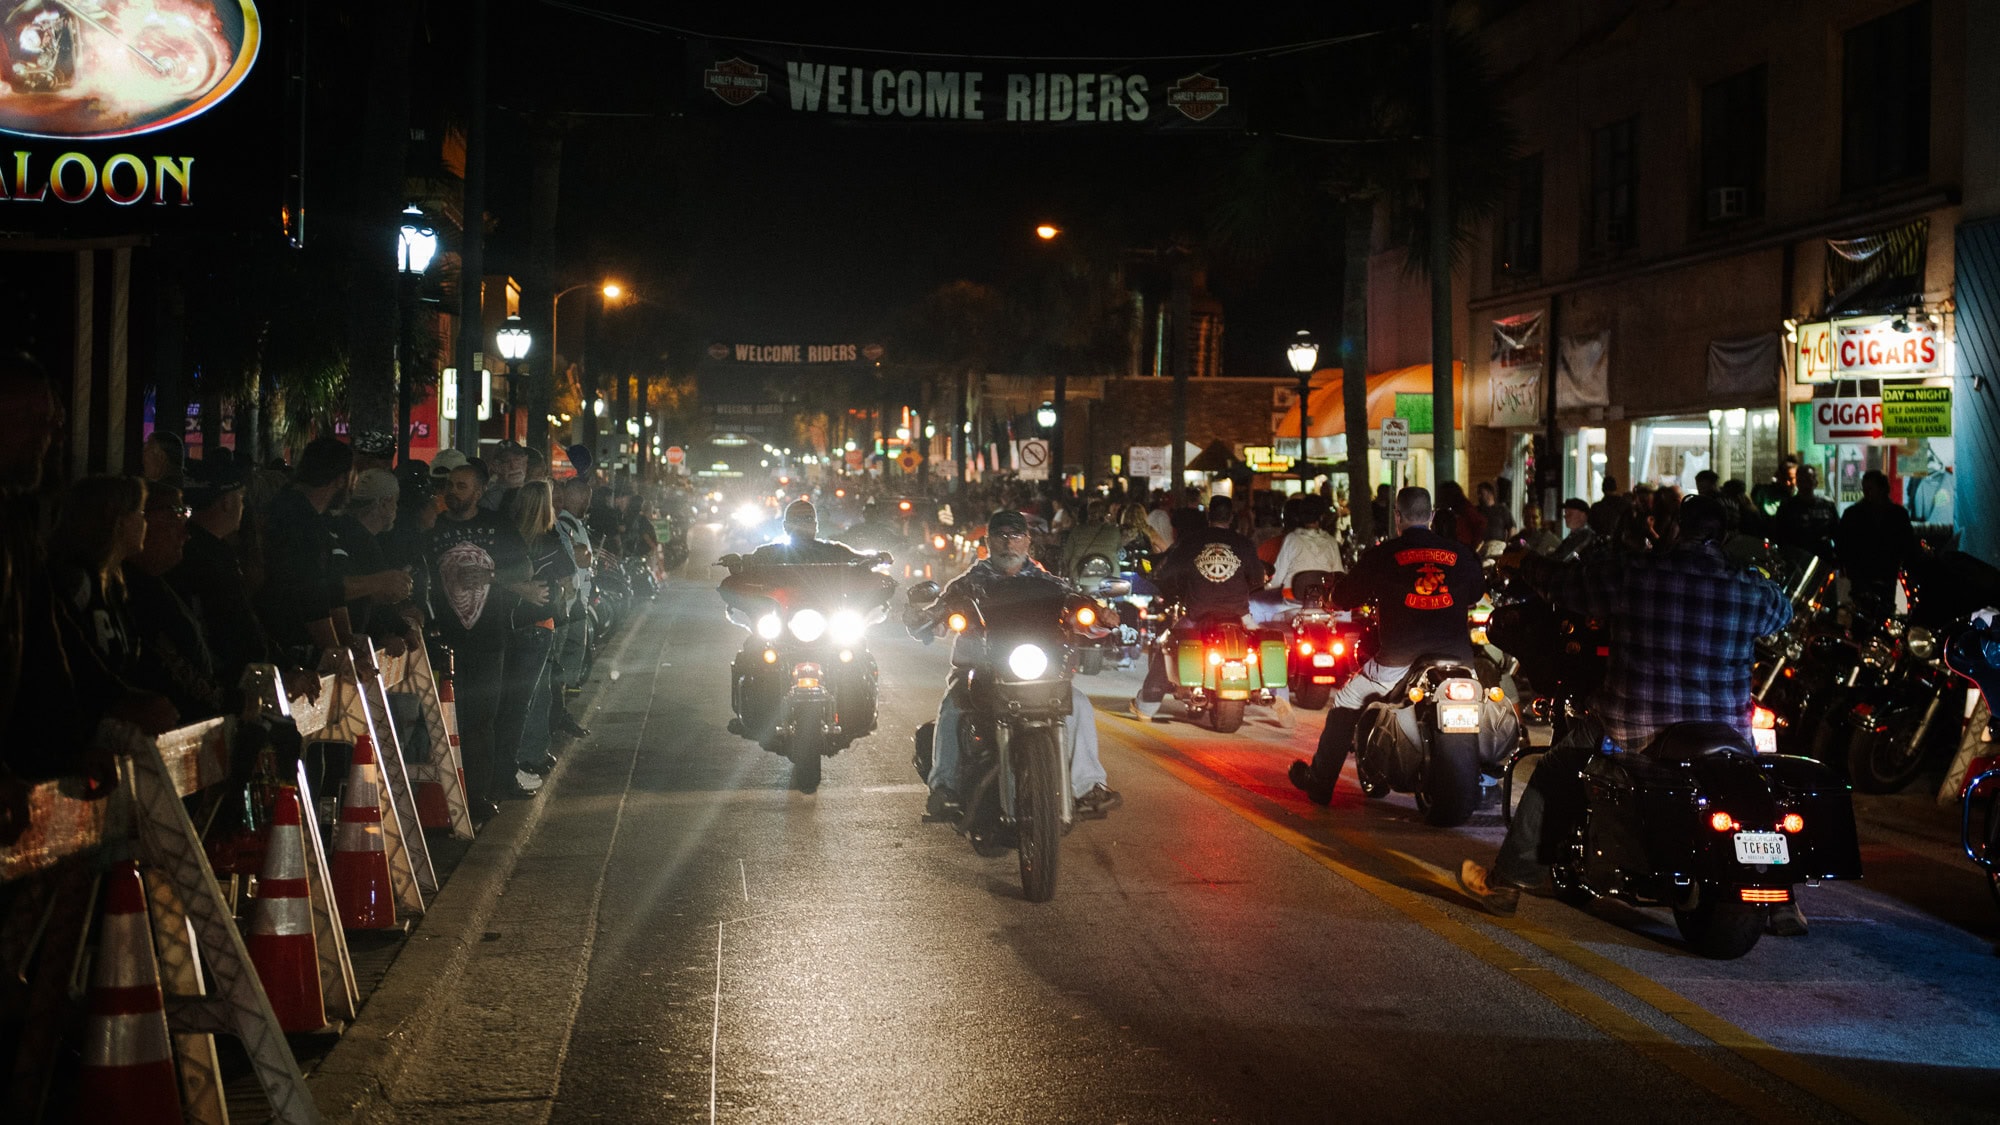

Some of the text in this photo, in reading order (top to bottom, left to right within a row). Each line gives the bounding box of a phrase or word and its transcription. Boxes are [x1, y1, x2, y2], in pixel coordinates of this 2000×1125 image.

[787, 61, 1150, 122] WELCOME RIDERS
[735, 344, 857, 362] WELCOME RIDERS
[1840, 336, 1935, 367] CIGARS
[1884, 390, 1905, 401] DAY
[1916, 389, 1948, 401] NIGHT
[1905, 406, 1945, 414] DARKENING
[1894, 415, 1939, 424] TRANSITION
[1886, 425, 1947, 433] RIDING GLASSES
